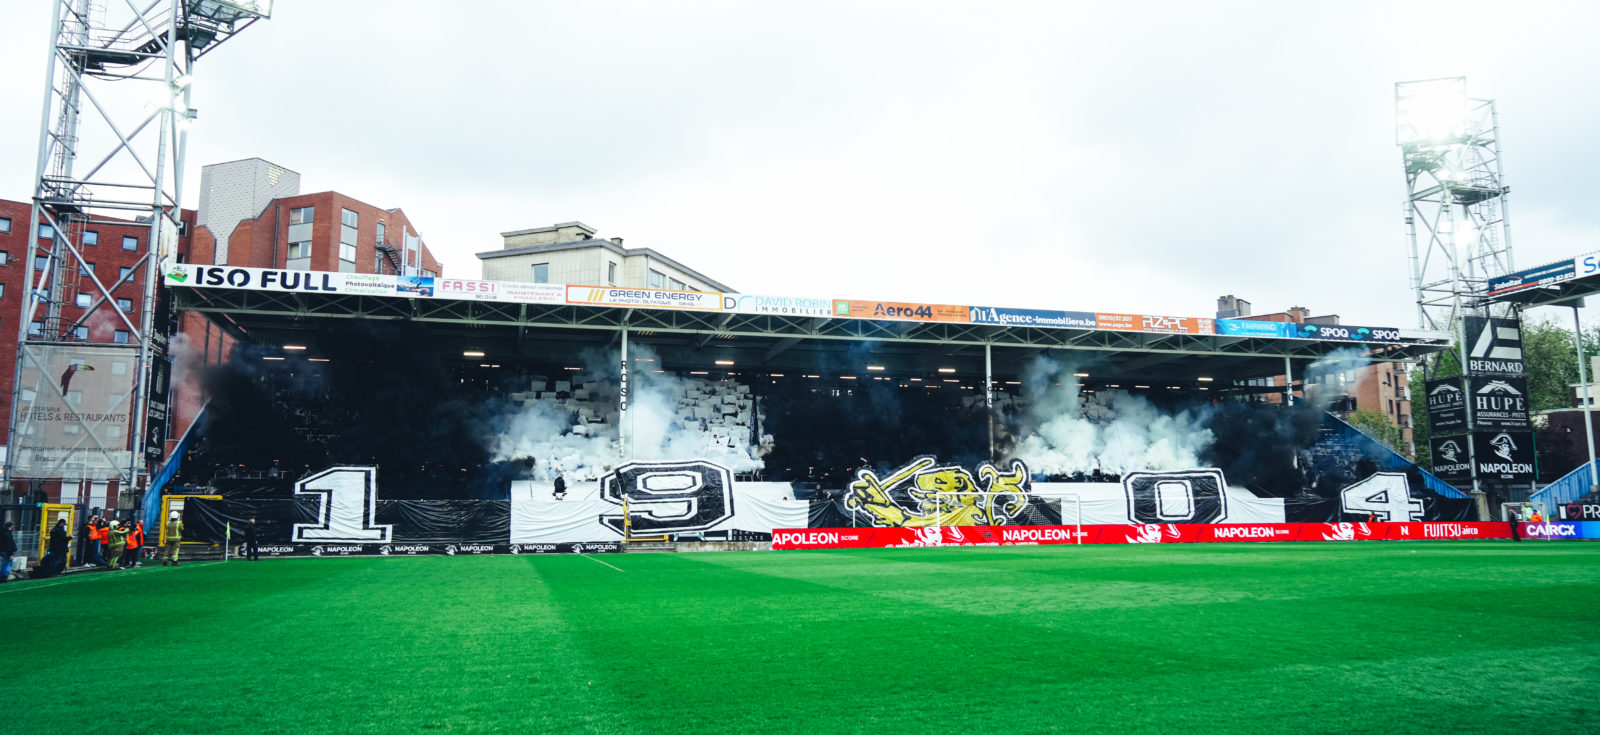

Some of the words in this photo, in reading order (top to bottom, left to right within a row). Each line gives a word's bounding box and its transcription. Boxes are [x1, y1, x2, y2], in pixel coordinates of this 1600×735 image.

[195, 266, 251, 287] ISO
[261, 270, 337, 292] FULL
[442, 280, 495, 293] FASSI
[609, 289, 653, 299] GREEN
[654, 291, 703, 302] ENERGY
[755, 295, 792, 306] DAVID
[795, 297, 831, 309] ROBIN
[755, 305, 832, 316] IMMOBILIER
[874, 302, 933, 318] Aero44
[1320, 327, 1349, 339] SPOQ
[1372, 329, 1401, 341] SPOQ
[1470, 360, 1523, 373] BERNARD
[55, 412, 61, 421] &
[63, 412, 126, 422] RESTAURANTS
[1434, 463, 1470, 473] NAPOLEON
[1480, 463, 1533, 474] NAPOLEON
[292, 466, 393, 544] 1
[598, 460, 735, 537] 9
[1341, 471, 1424, 523] 4
[1002, 529, 1070, 542] NAPOLEON
[1214, 527, 1275, 538] NAPOLEON
[1400, 526, 1409, 535] N
[1423, 524, 1462, 537] FUJITSU
[1462, 526, 1479, 535] airco
